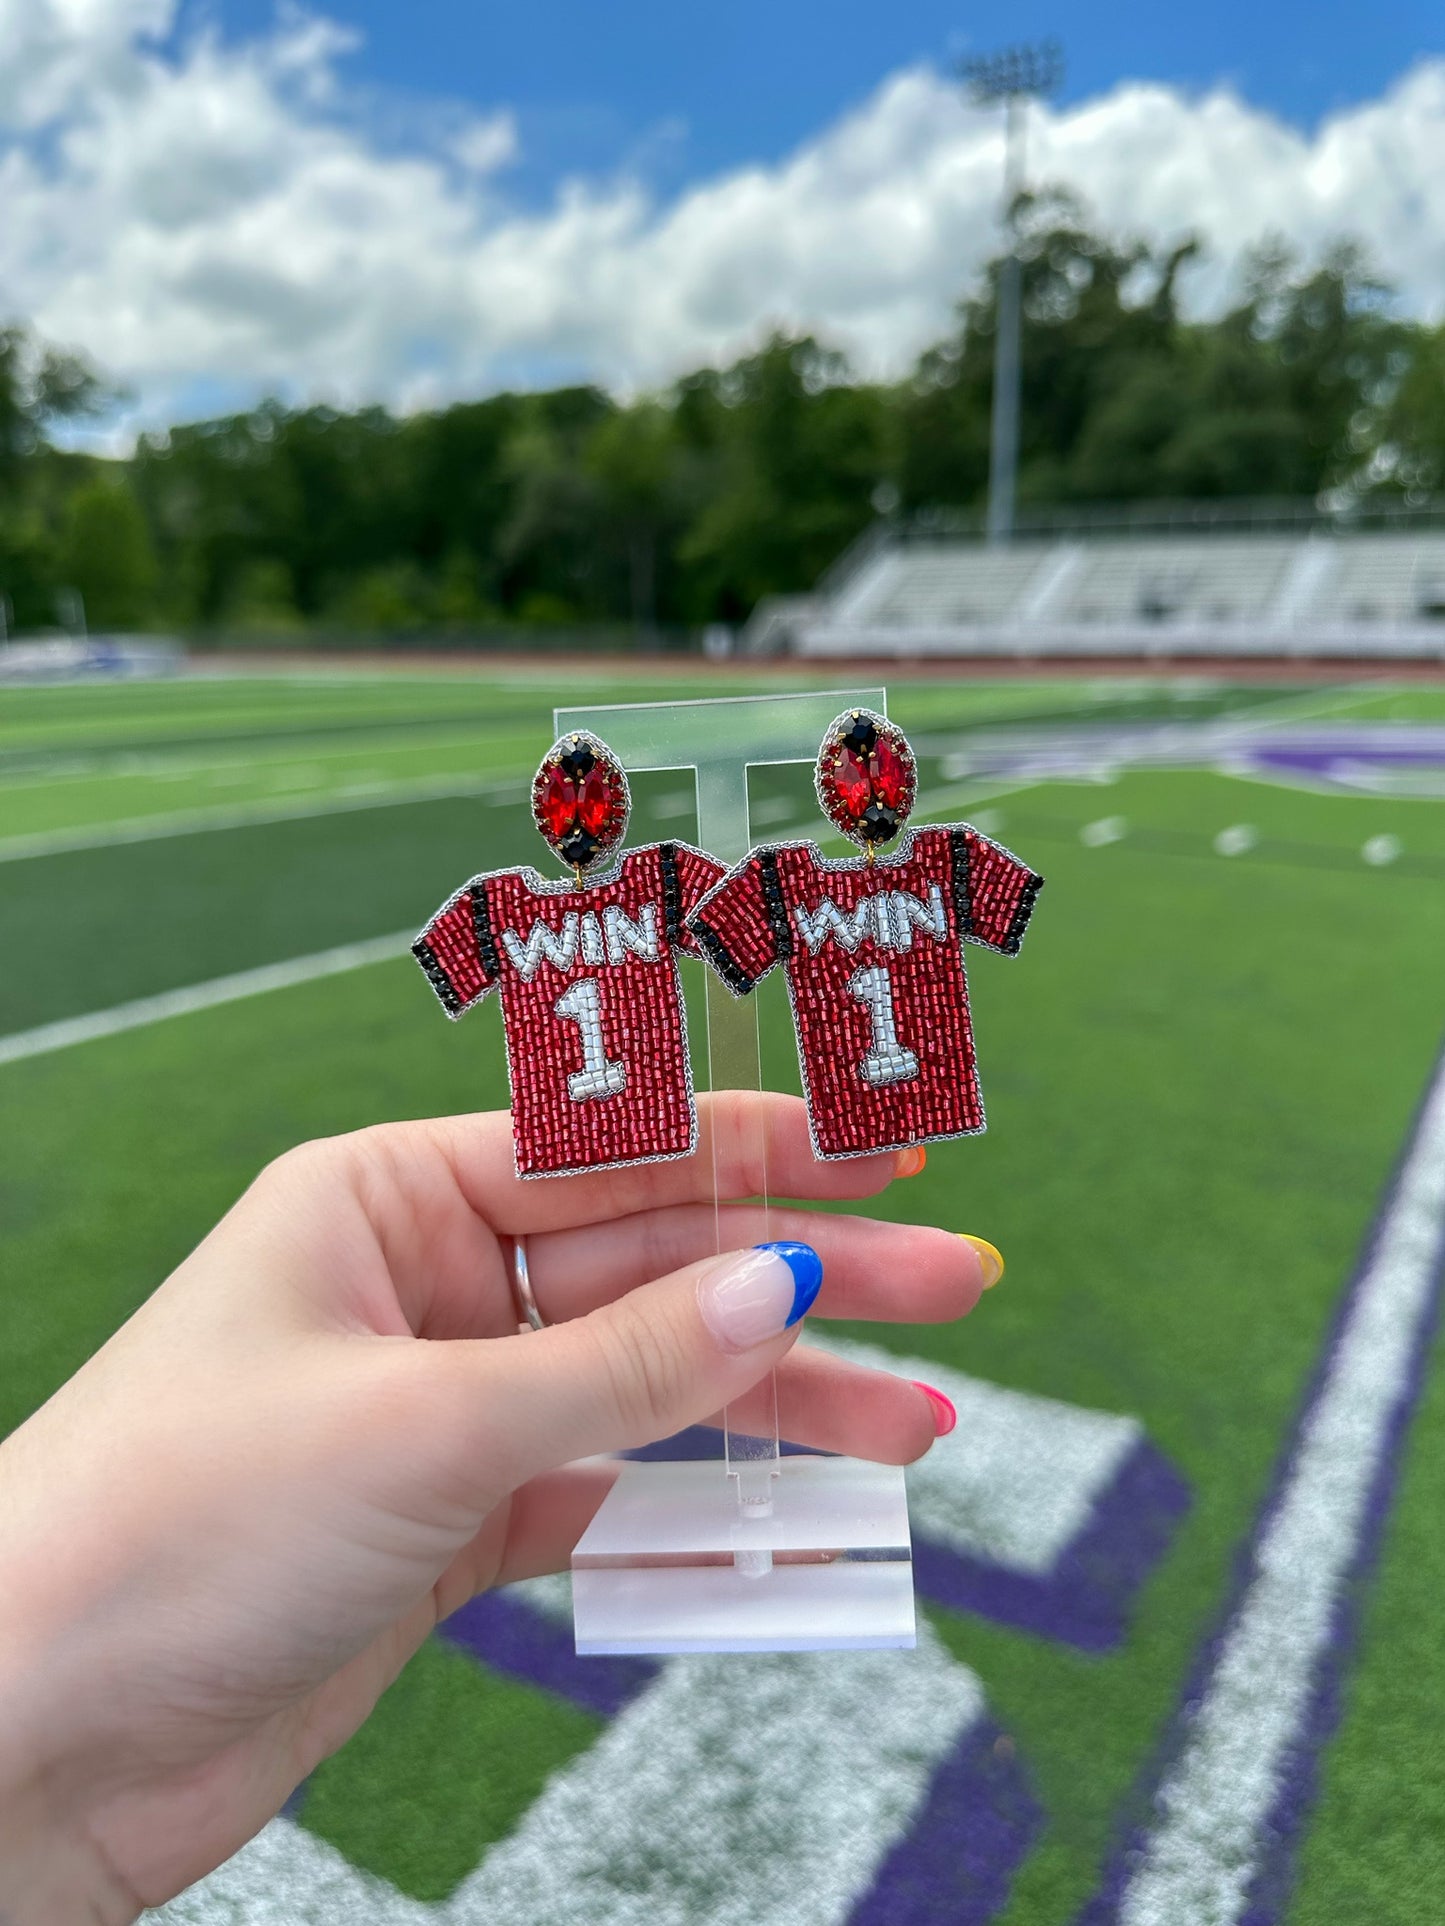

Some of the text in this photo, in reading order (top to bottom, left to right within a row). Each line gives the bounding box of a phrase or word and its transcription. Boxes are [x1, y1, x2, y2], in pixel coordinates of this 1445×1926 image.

[502, 901, 659, 983] WIN
[794, 880, 948, 956] WIN
[554, 978, 626, 1101] 1
[847, 965, 919, 1087] 1
